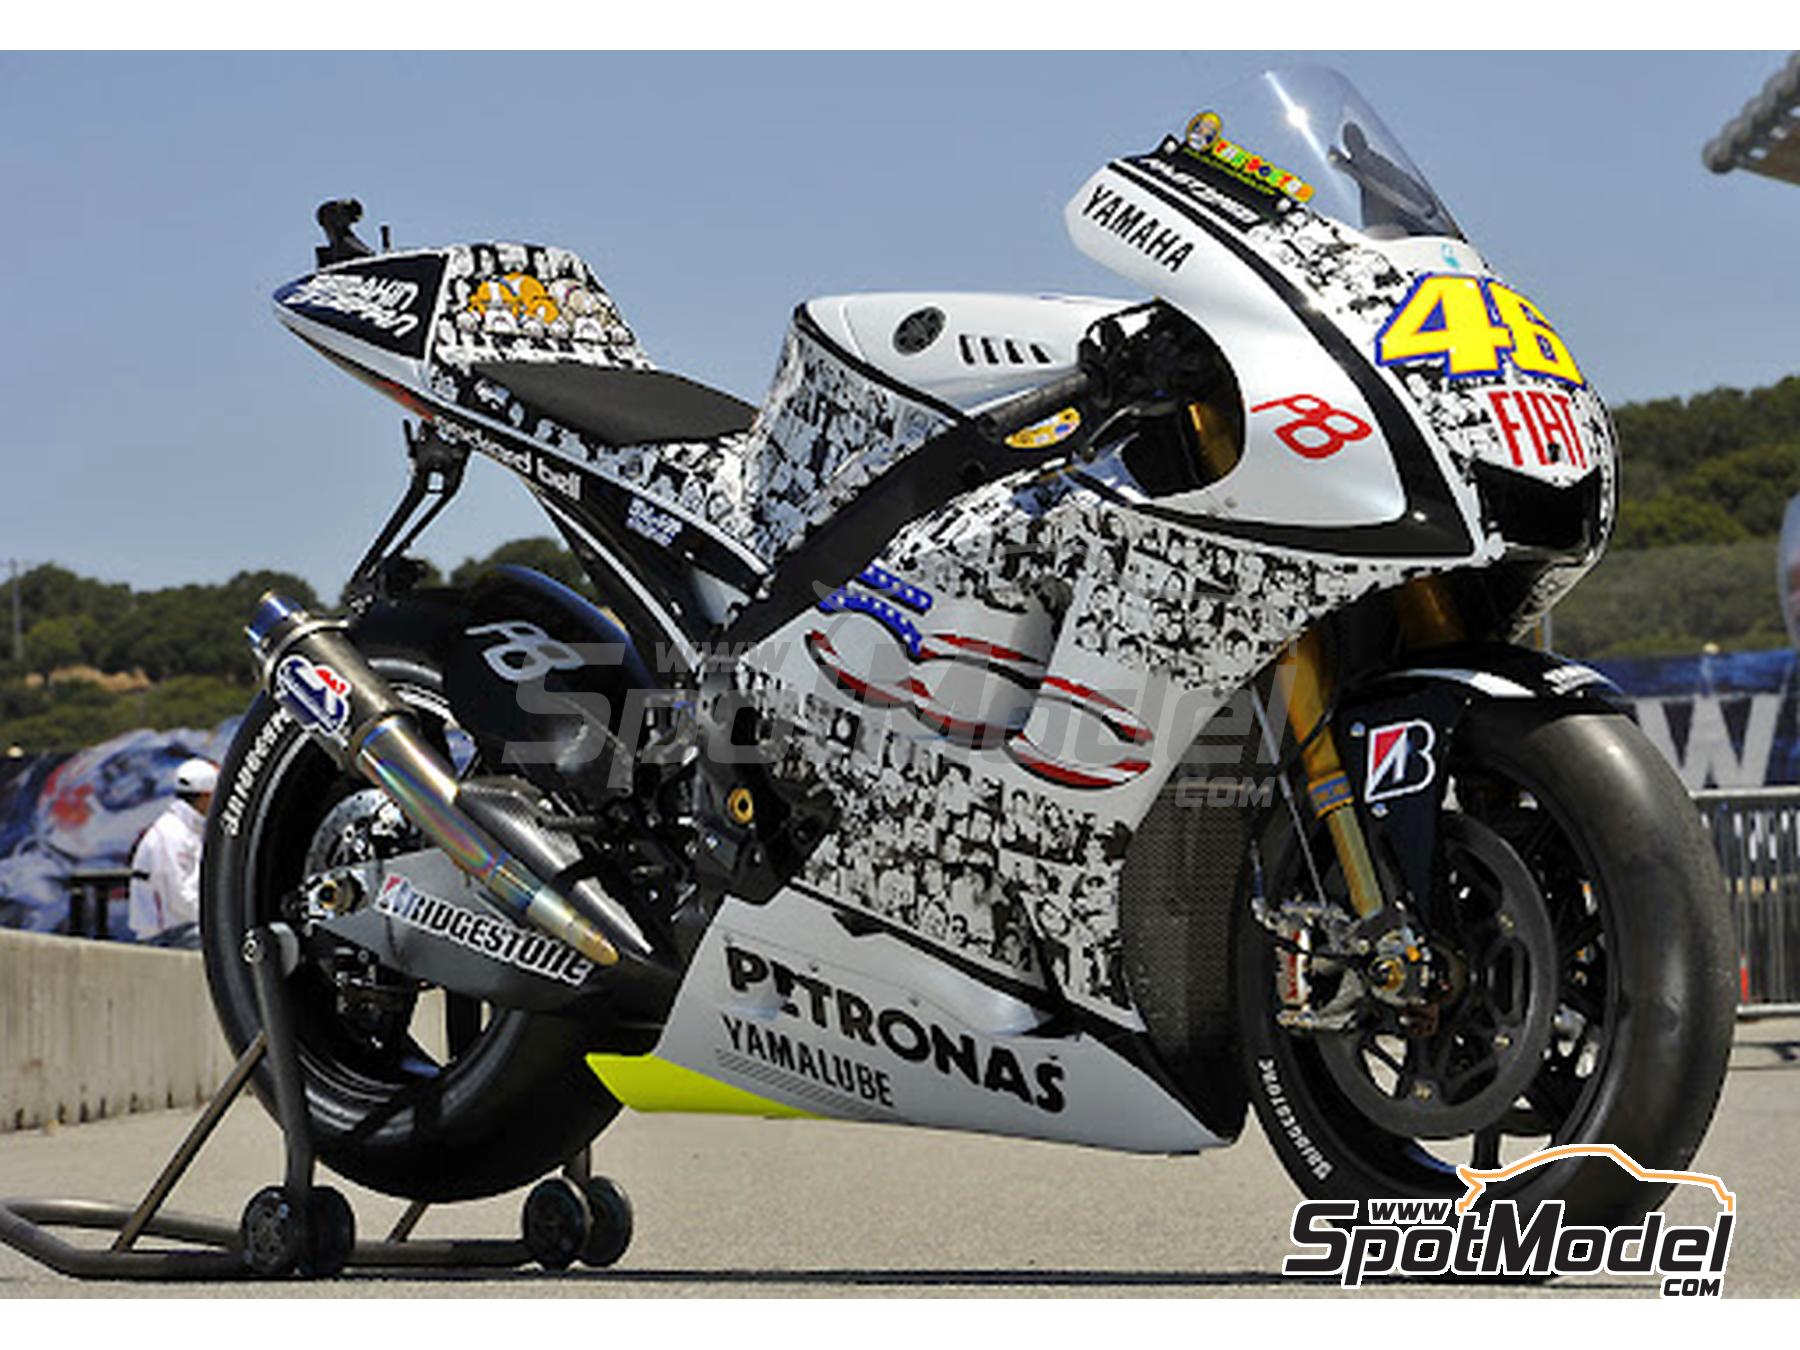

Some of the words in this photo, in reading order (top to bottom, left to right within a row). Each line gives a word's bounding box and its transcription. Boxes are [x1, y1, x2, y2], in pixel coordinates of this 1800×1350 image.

[1081, 183, 1195, 273] YAMAHA
[1375, 270, 1588, 393] 46
[1487, 390, 1588, 471] FIAT
[376, 874, 594, 986] BRIDGESTONE
[721, 1013, 894, 1108] YAMALUBE
[724, 944, 1066, 1113] PETRONAS
